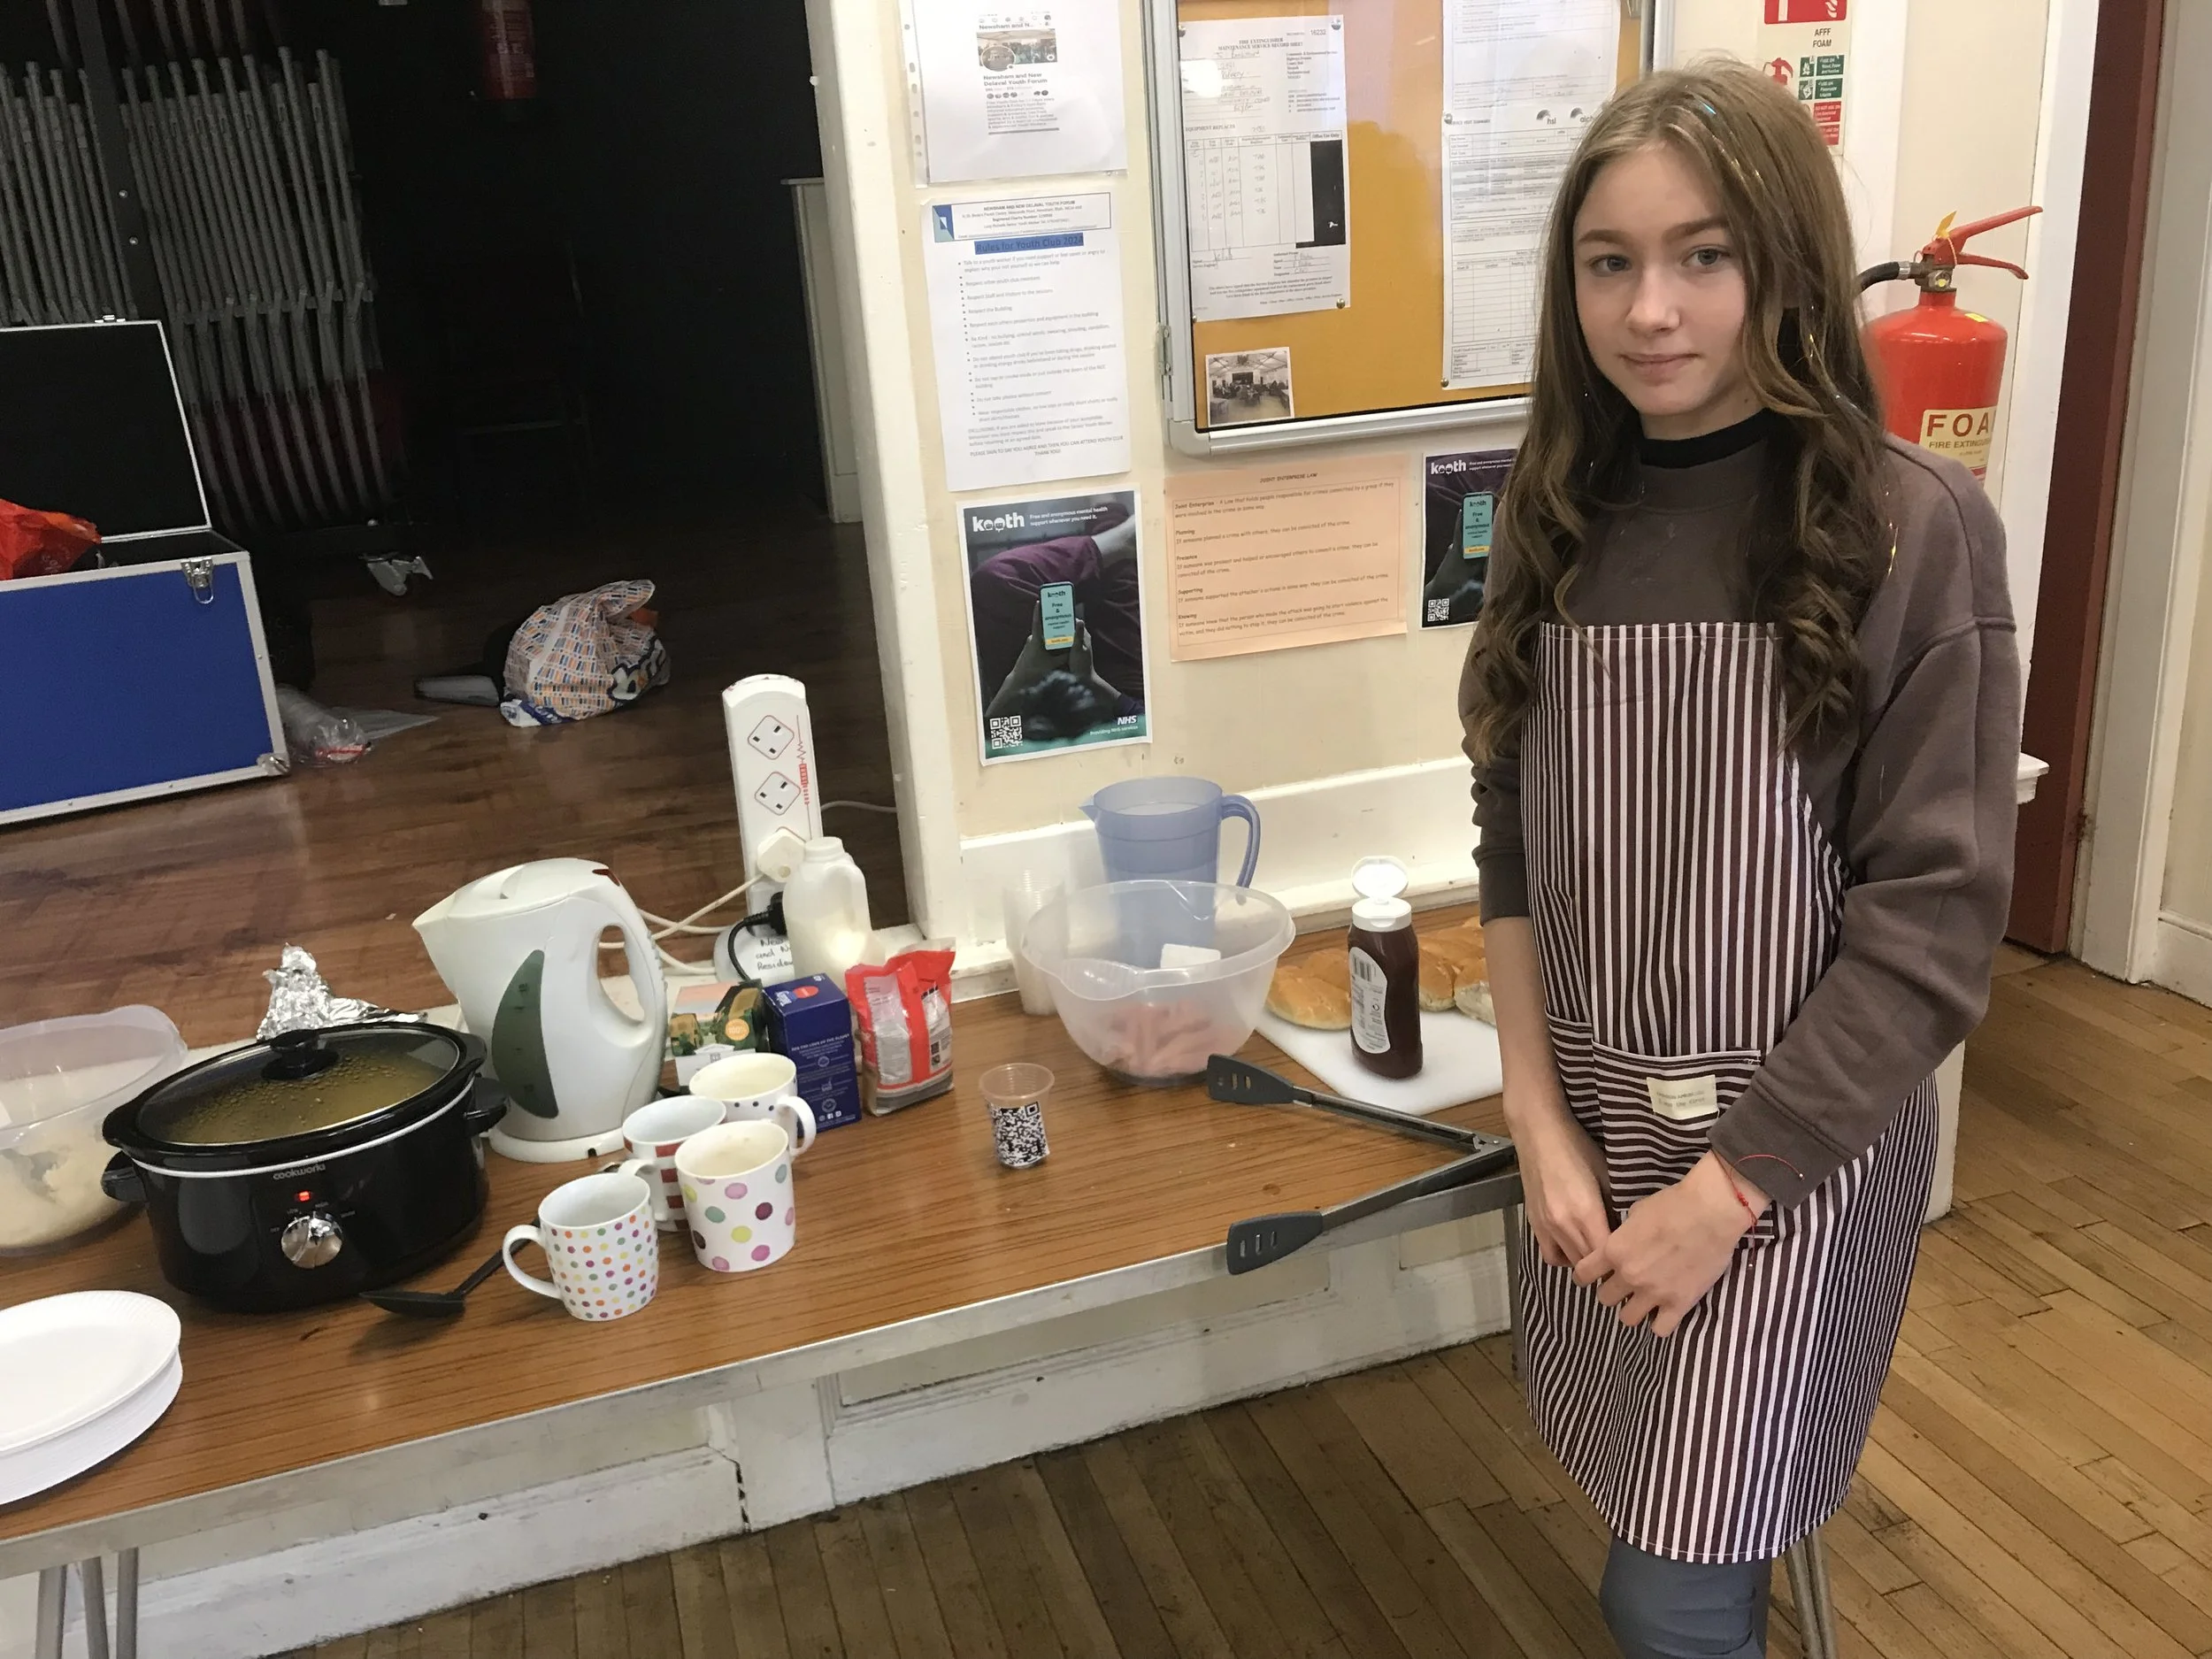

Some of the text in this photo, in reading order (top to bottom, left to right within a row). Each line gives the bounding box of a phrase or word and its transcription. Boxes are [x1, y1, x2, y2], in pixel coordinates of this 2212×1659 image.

[977, 243, 1000, 252] Rules
[1017, 241, 1040, 250] Youth
[1042, 238, 1061, 247] Club
[1927, 411, 1996, 437] FOA
[1431, 460, 1466, 474] kooth
[972, 512, 1025, 532] kooth
[1118, 716, 1137, 726] NHS
